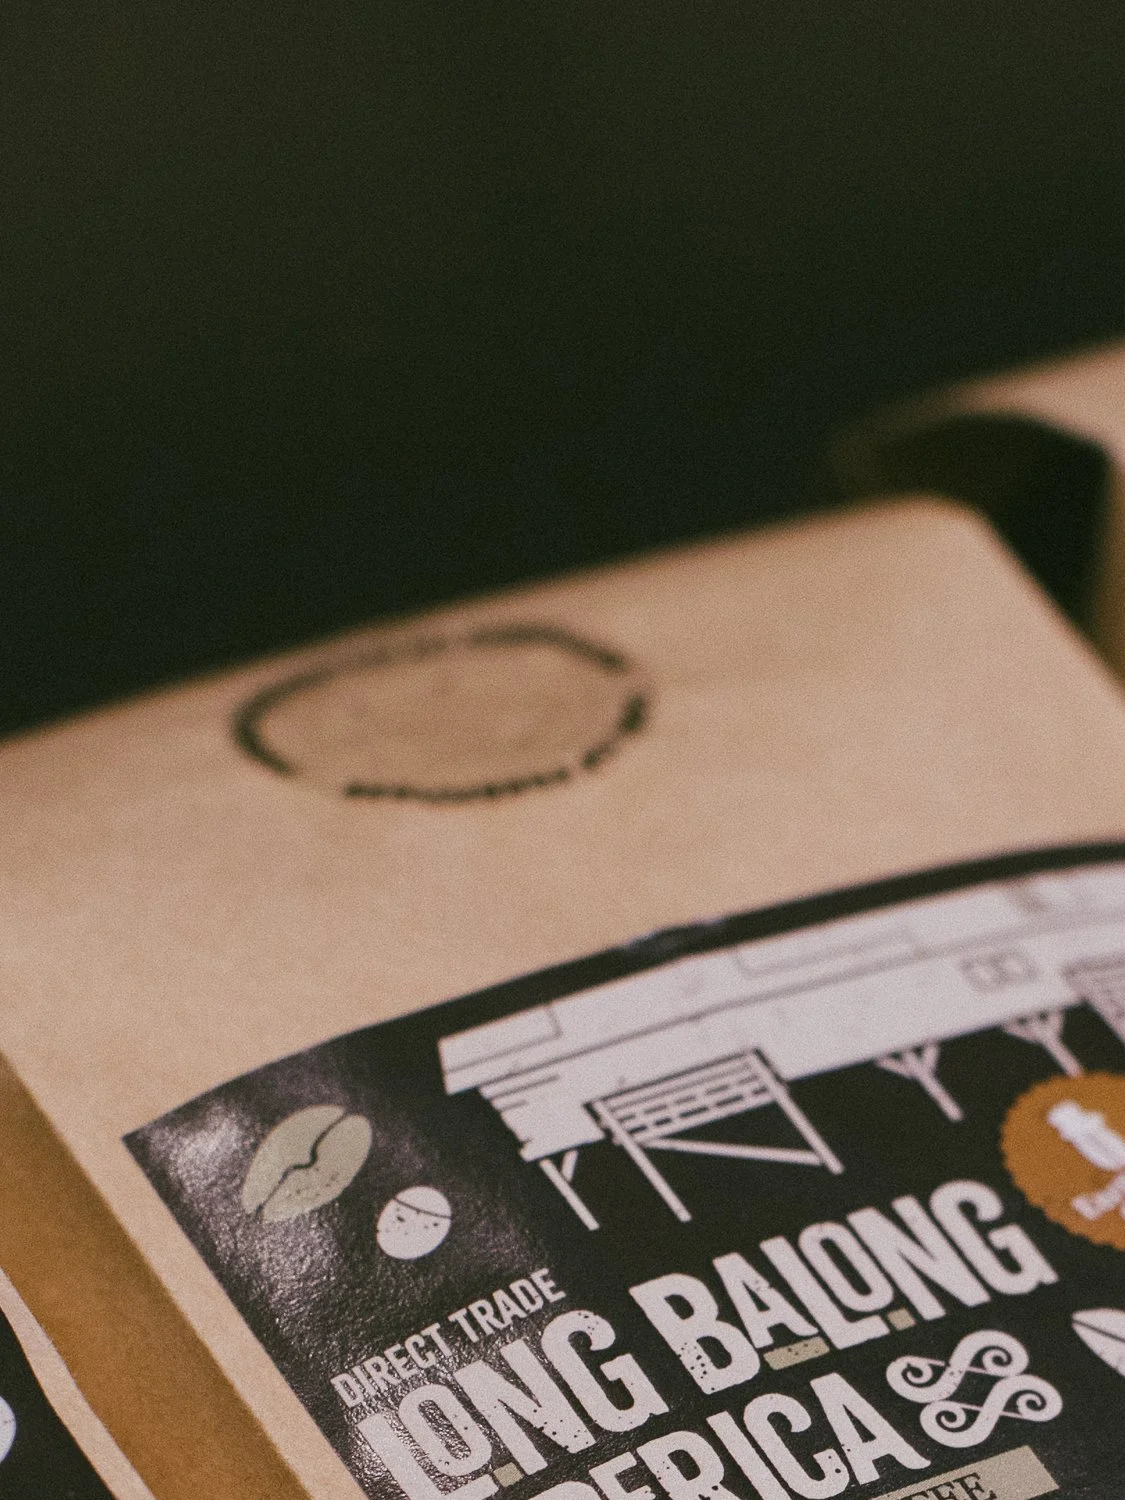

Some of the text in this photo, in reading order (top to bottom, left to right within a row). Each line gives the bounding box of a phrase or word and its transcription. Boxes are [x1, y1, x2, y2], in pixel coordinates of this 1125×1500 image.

[331, 1268, 566, 1407] DIRECT TRADE
[629, 1180, 1058, 1395] BALONG
